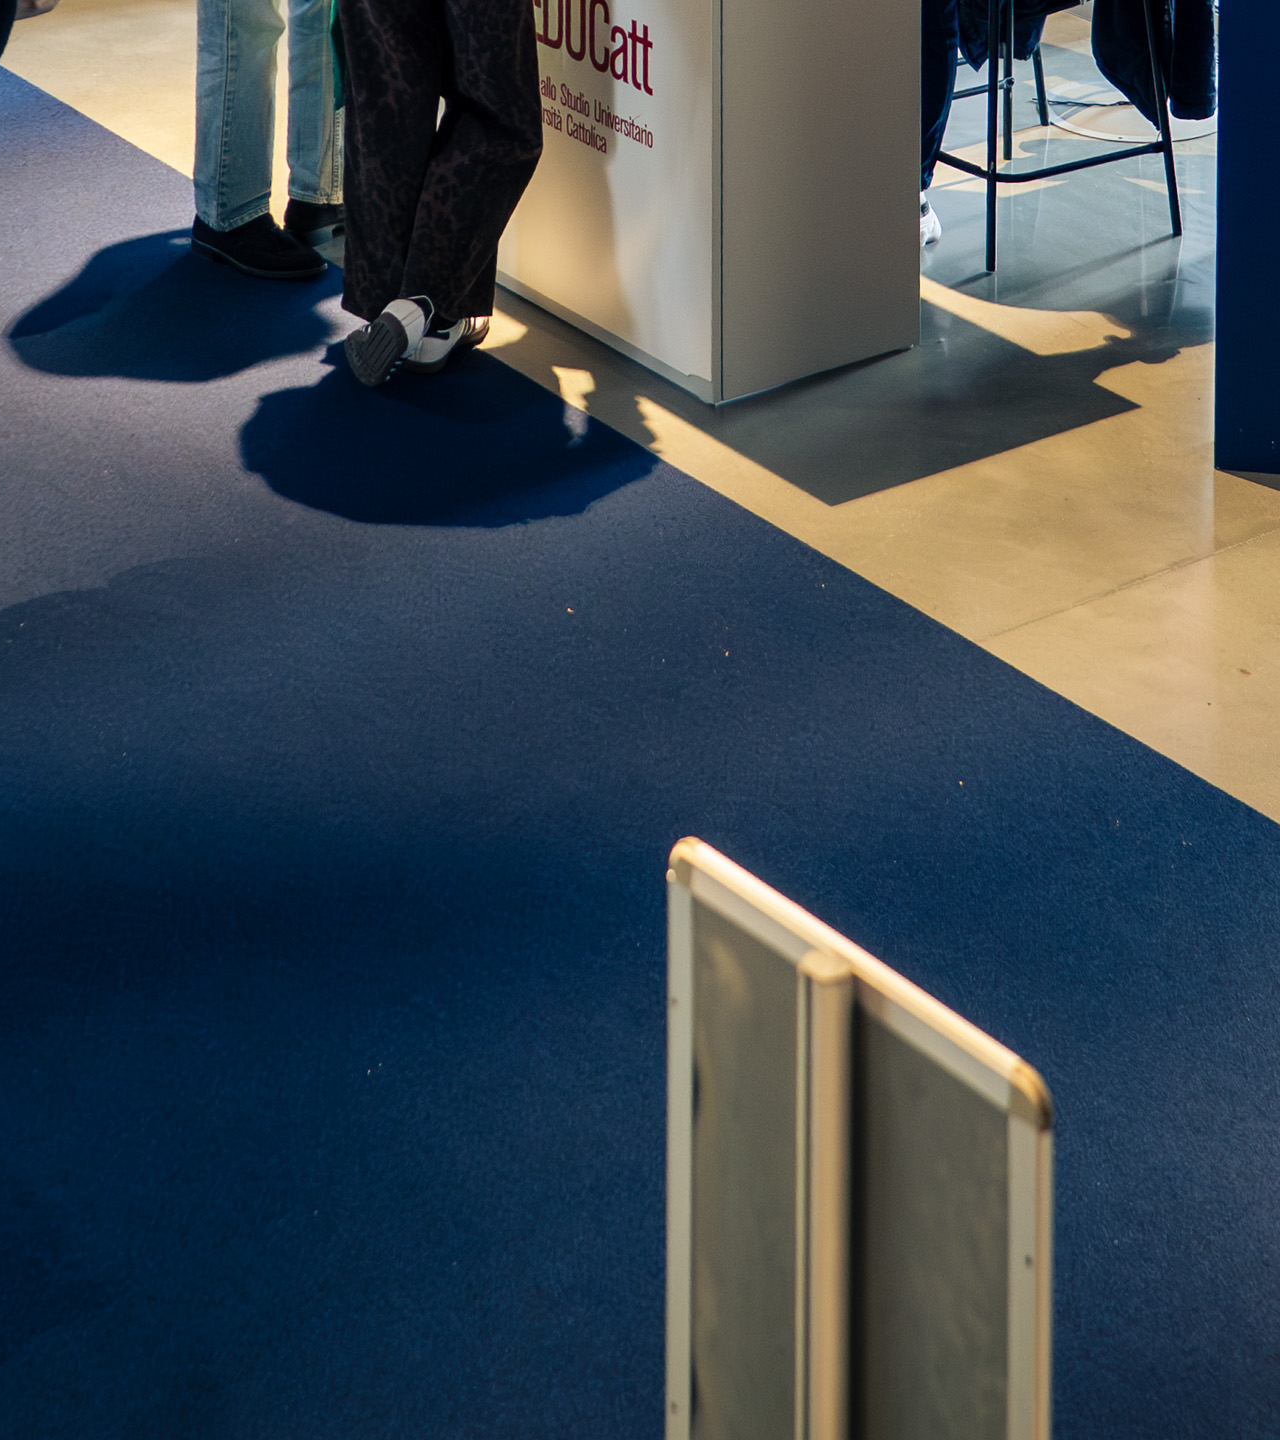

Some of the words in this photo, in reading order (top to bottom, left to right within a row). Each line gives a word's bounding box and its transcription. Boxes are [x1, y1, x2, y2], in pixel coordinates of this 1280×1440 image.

[540, 75, 557, 101] allo
[560, 83, 590, 117] Studio
[594, 98, 654, 150] Universitario
[566, 115, 608, 155] Cattolica
